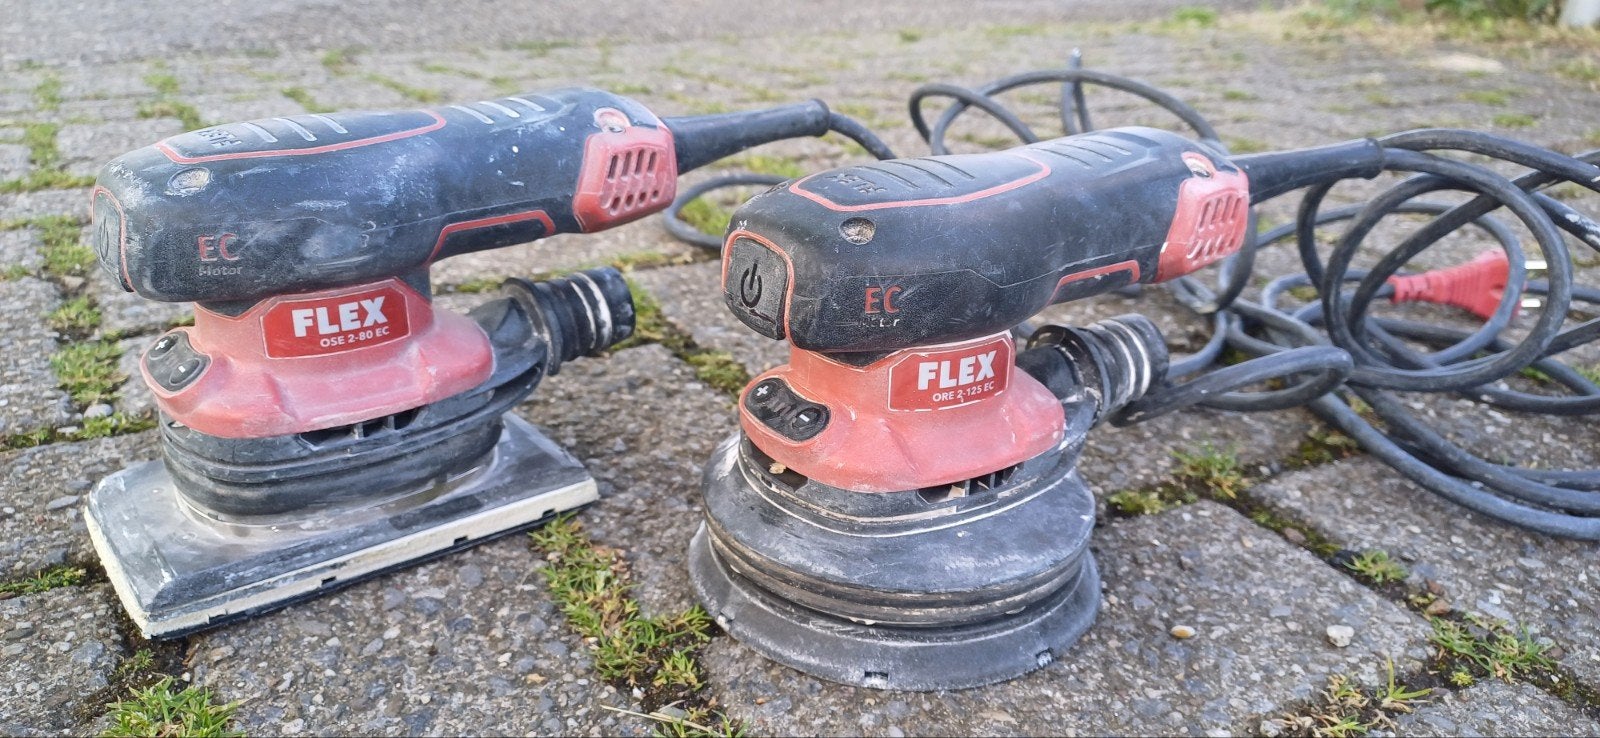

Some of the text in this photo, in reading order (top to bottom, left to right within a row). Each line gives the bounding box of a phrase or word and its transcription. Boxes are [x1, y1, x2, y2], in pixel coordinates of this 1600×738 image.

[197, 232, 240, 262] EC
[198, 265, 243, 277] Motor
[865, 285, 902, 314] EC
[291, 296, 388, 338] FLEX
[320, 326, 390, 348] OSE 2-80 EC
[917, 350, 998, 391] FLEX
[932, 381, 995, 402] ORE 2-125 EC
